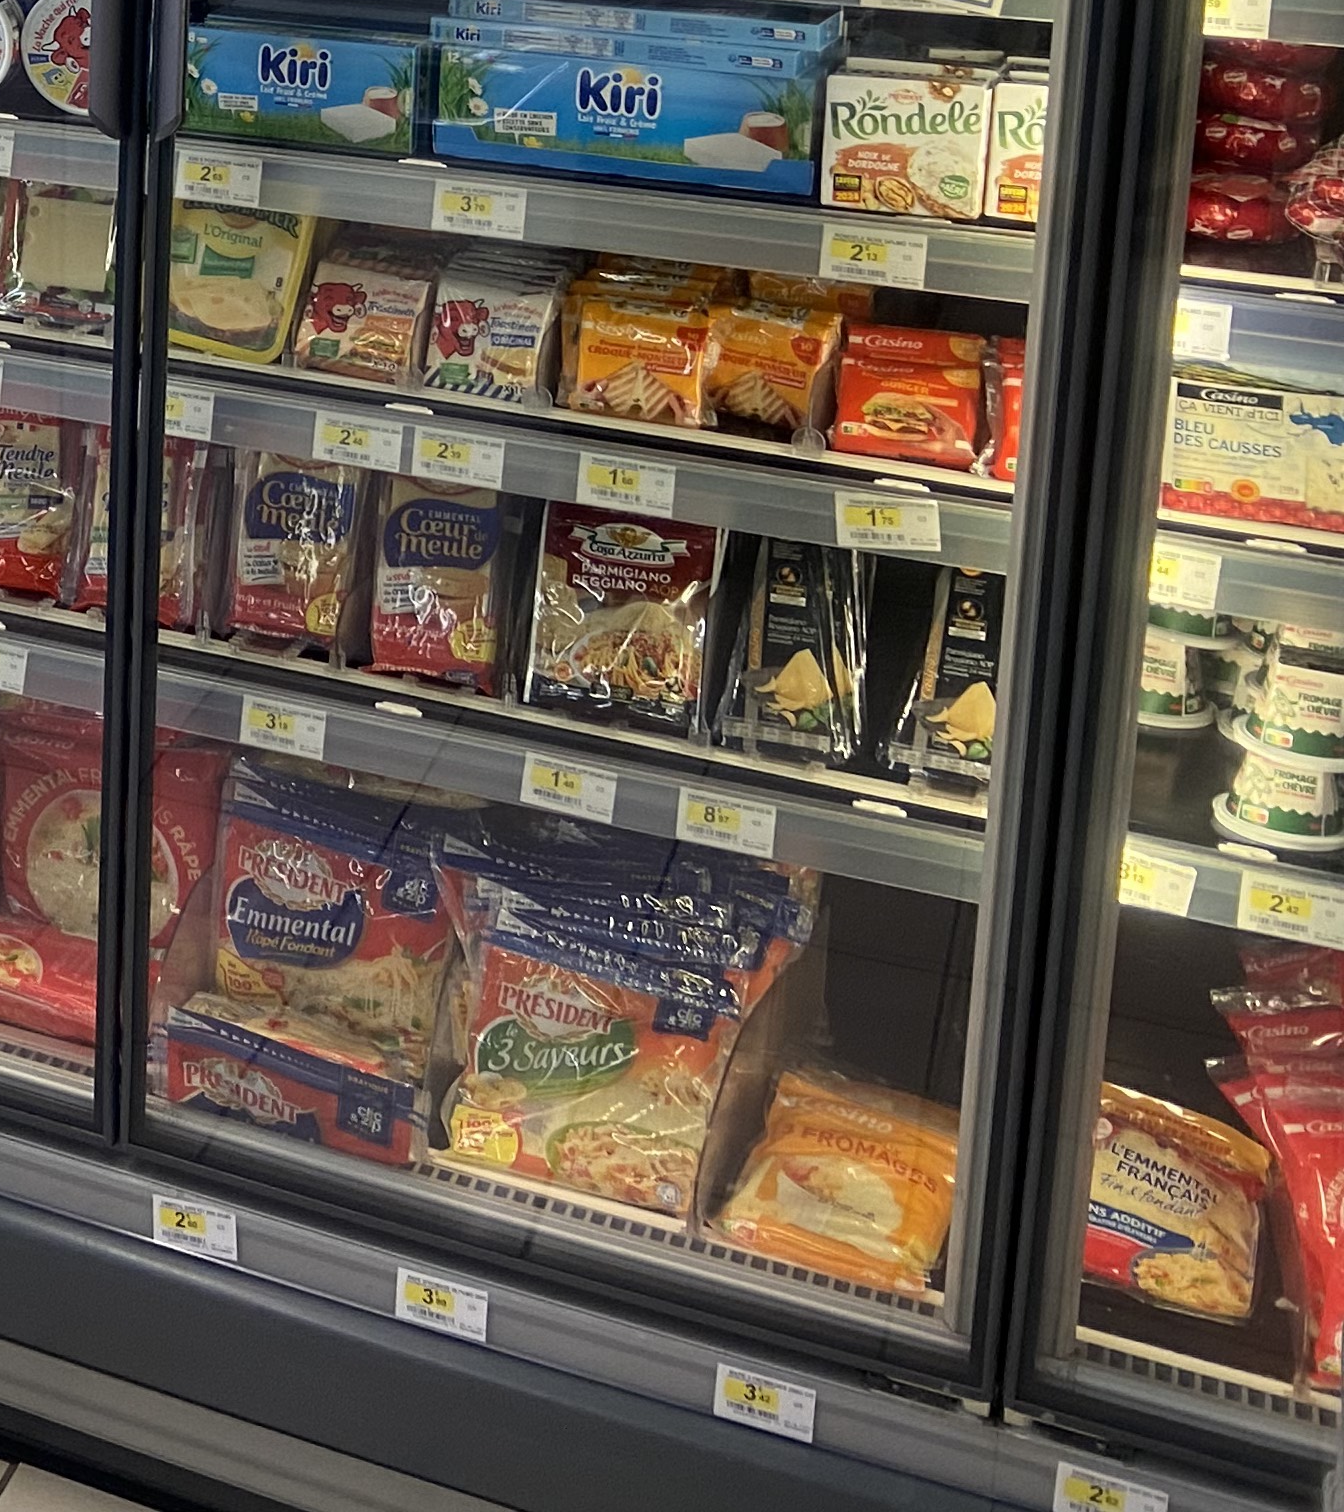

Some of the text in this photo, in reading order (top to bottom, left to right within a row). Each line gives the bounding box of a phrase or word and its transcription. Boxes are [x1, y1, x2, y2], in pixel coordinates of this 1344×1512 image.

[476, 0, 502, 17] Kiri
[456, 26, 481, 42] Kiri
[258, 43, 332, 91] Kiri
[576, 67, 662, 120] Kiri
[829, 98, 982, 141] Rondelé
[848, 157, 900, 173] DORDOGNE
[203, 223, 264, 249] L'Original
[863, 334, 924, 351] Casino
[1200, 388, 1259, 405] Casino
[1203, 404, 1243, 417] VIENT
[1174, 418, 1215, 435] BLEU
[1174, 433, 1282, 458] DES CAUSSES
[427, 508, 482, 525] EMMENTAL
[396, 536, 483, 560] meule
[580, 561, 672, 585] PARMIGIANO
[1298, 692, 1343, 708] FROMAGE
[1274, 768, 1318, 786] FROMAGE
[232, 898, 357, 947] Emmental
[498, 982, 615, 1035] PRÉSIDENT
[488, 1040, 625, 1075] 3 Saveurs
[1116, 1158, 1212, 1212] FRANÇAIS
